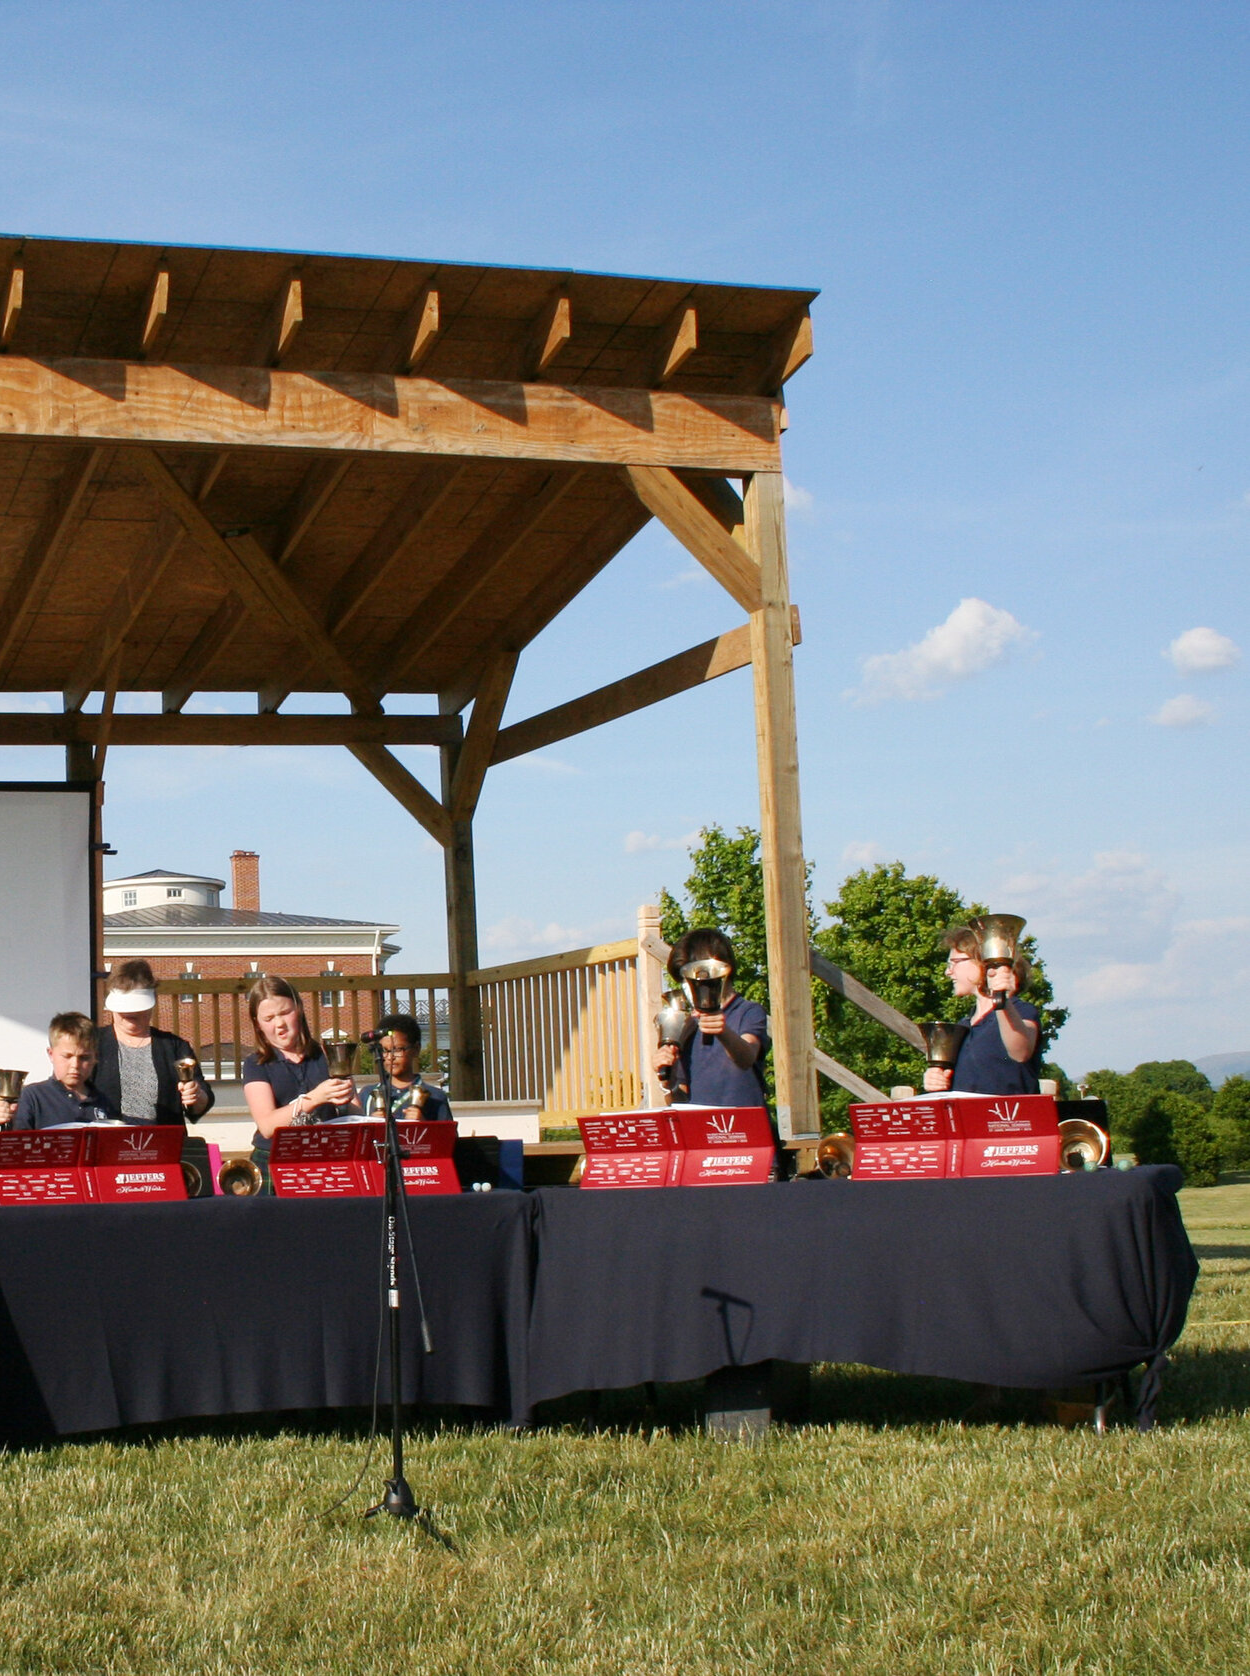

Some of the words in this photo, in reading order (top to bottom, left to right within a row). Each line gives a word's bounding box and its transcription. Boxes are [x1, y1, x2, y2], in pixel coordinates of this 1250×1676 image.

[994, 1145, 1039, 1156] JEFFERS
[711, 1155, 754, 1166] JEFFERS
[403, 1166, 439, 1175] EFFERS
[125, 1173, 166, 1183] JEFFERS
